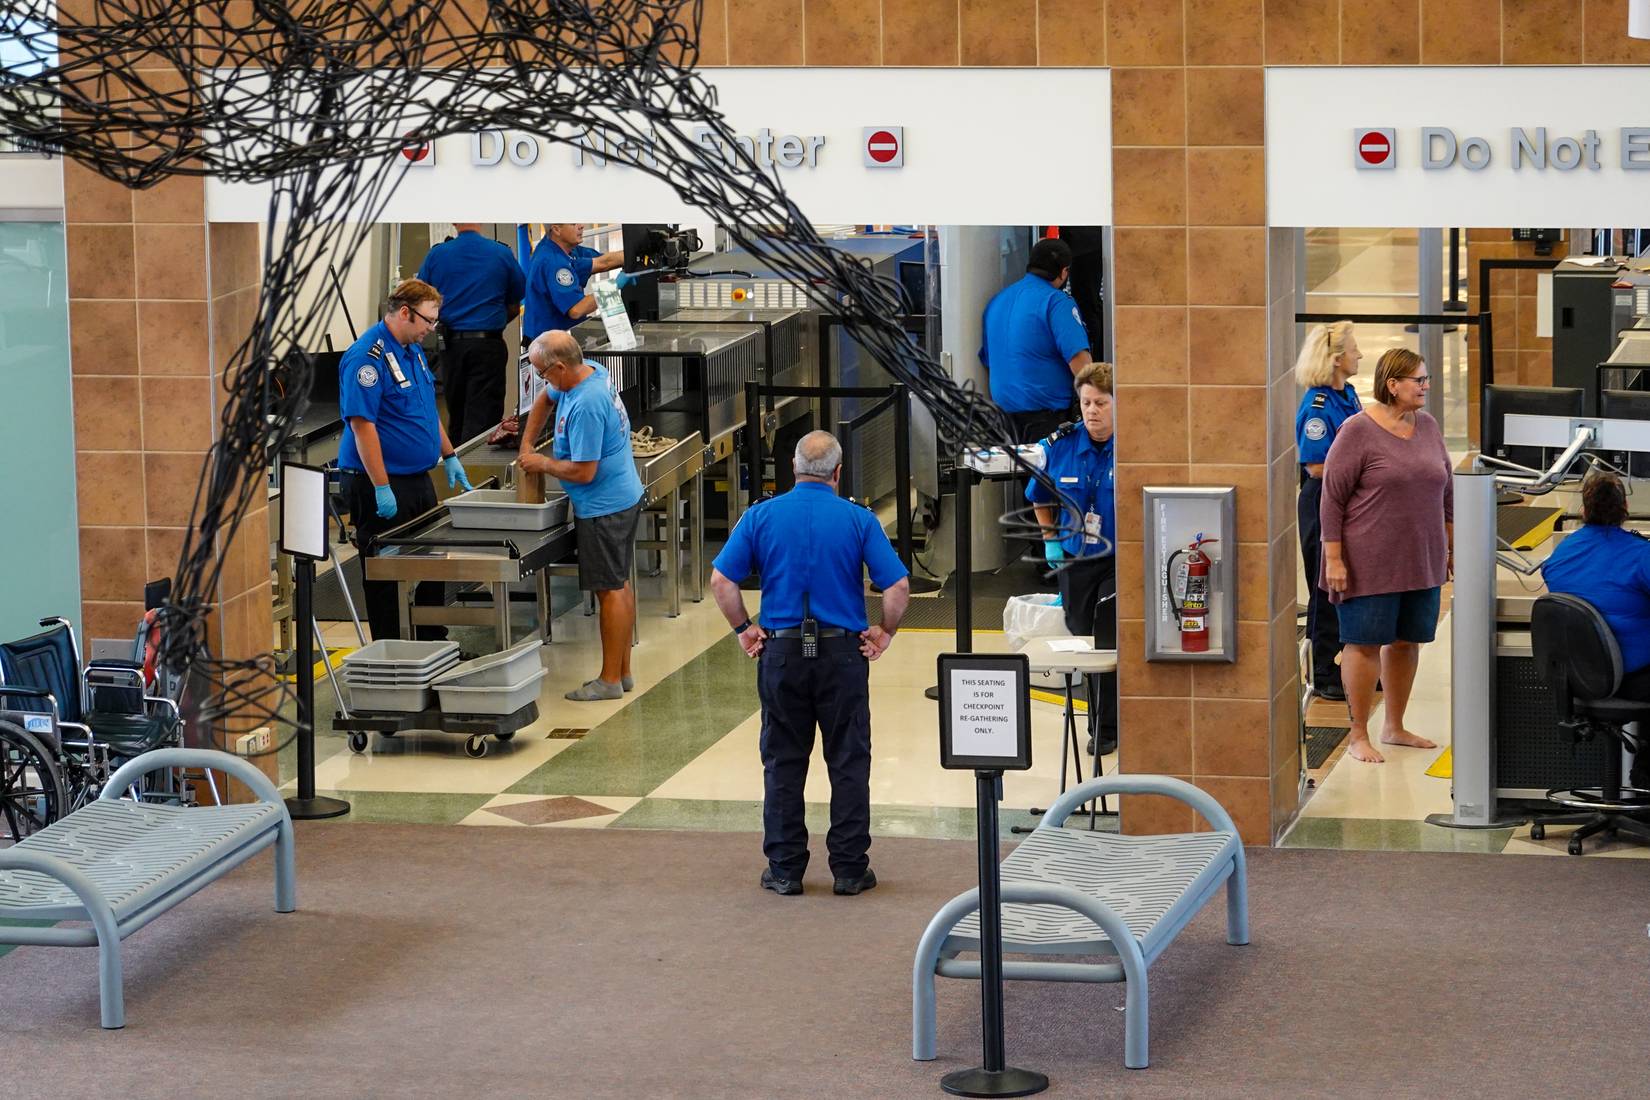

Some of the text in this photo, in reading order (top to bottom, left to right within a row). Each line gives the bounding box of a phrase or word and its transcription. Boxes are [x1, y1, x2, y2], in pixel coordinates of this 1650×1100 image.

[472, 127, 825, 168] Do Not Enter
[1421, 126, 1491, 170] Do
[1510, 126, 1601, 170] Not
